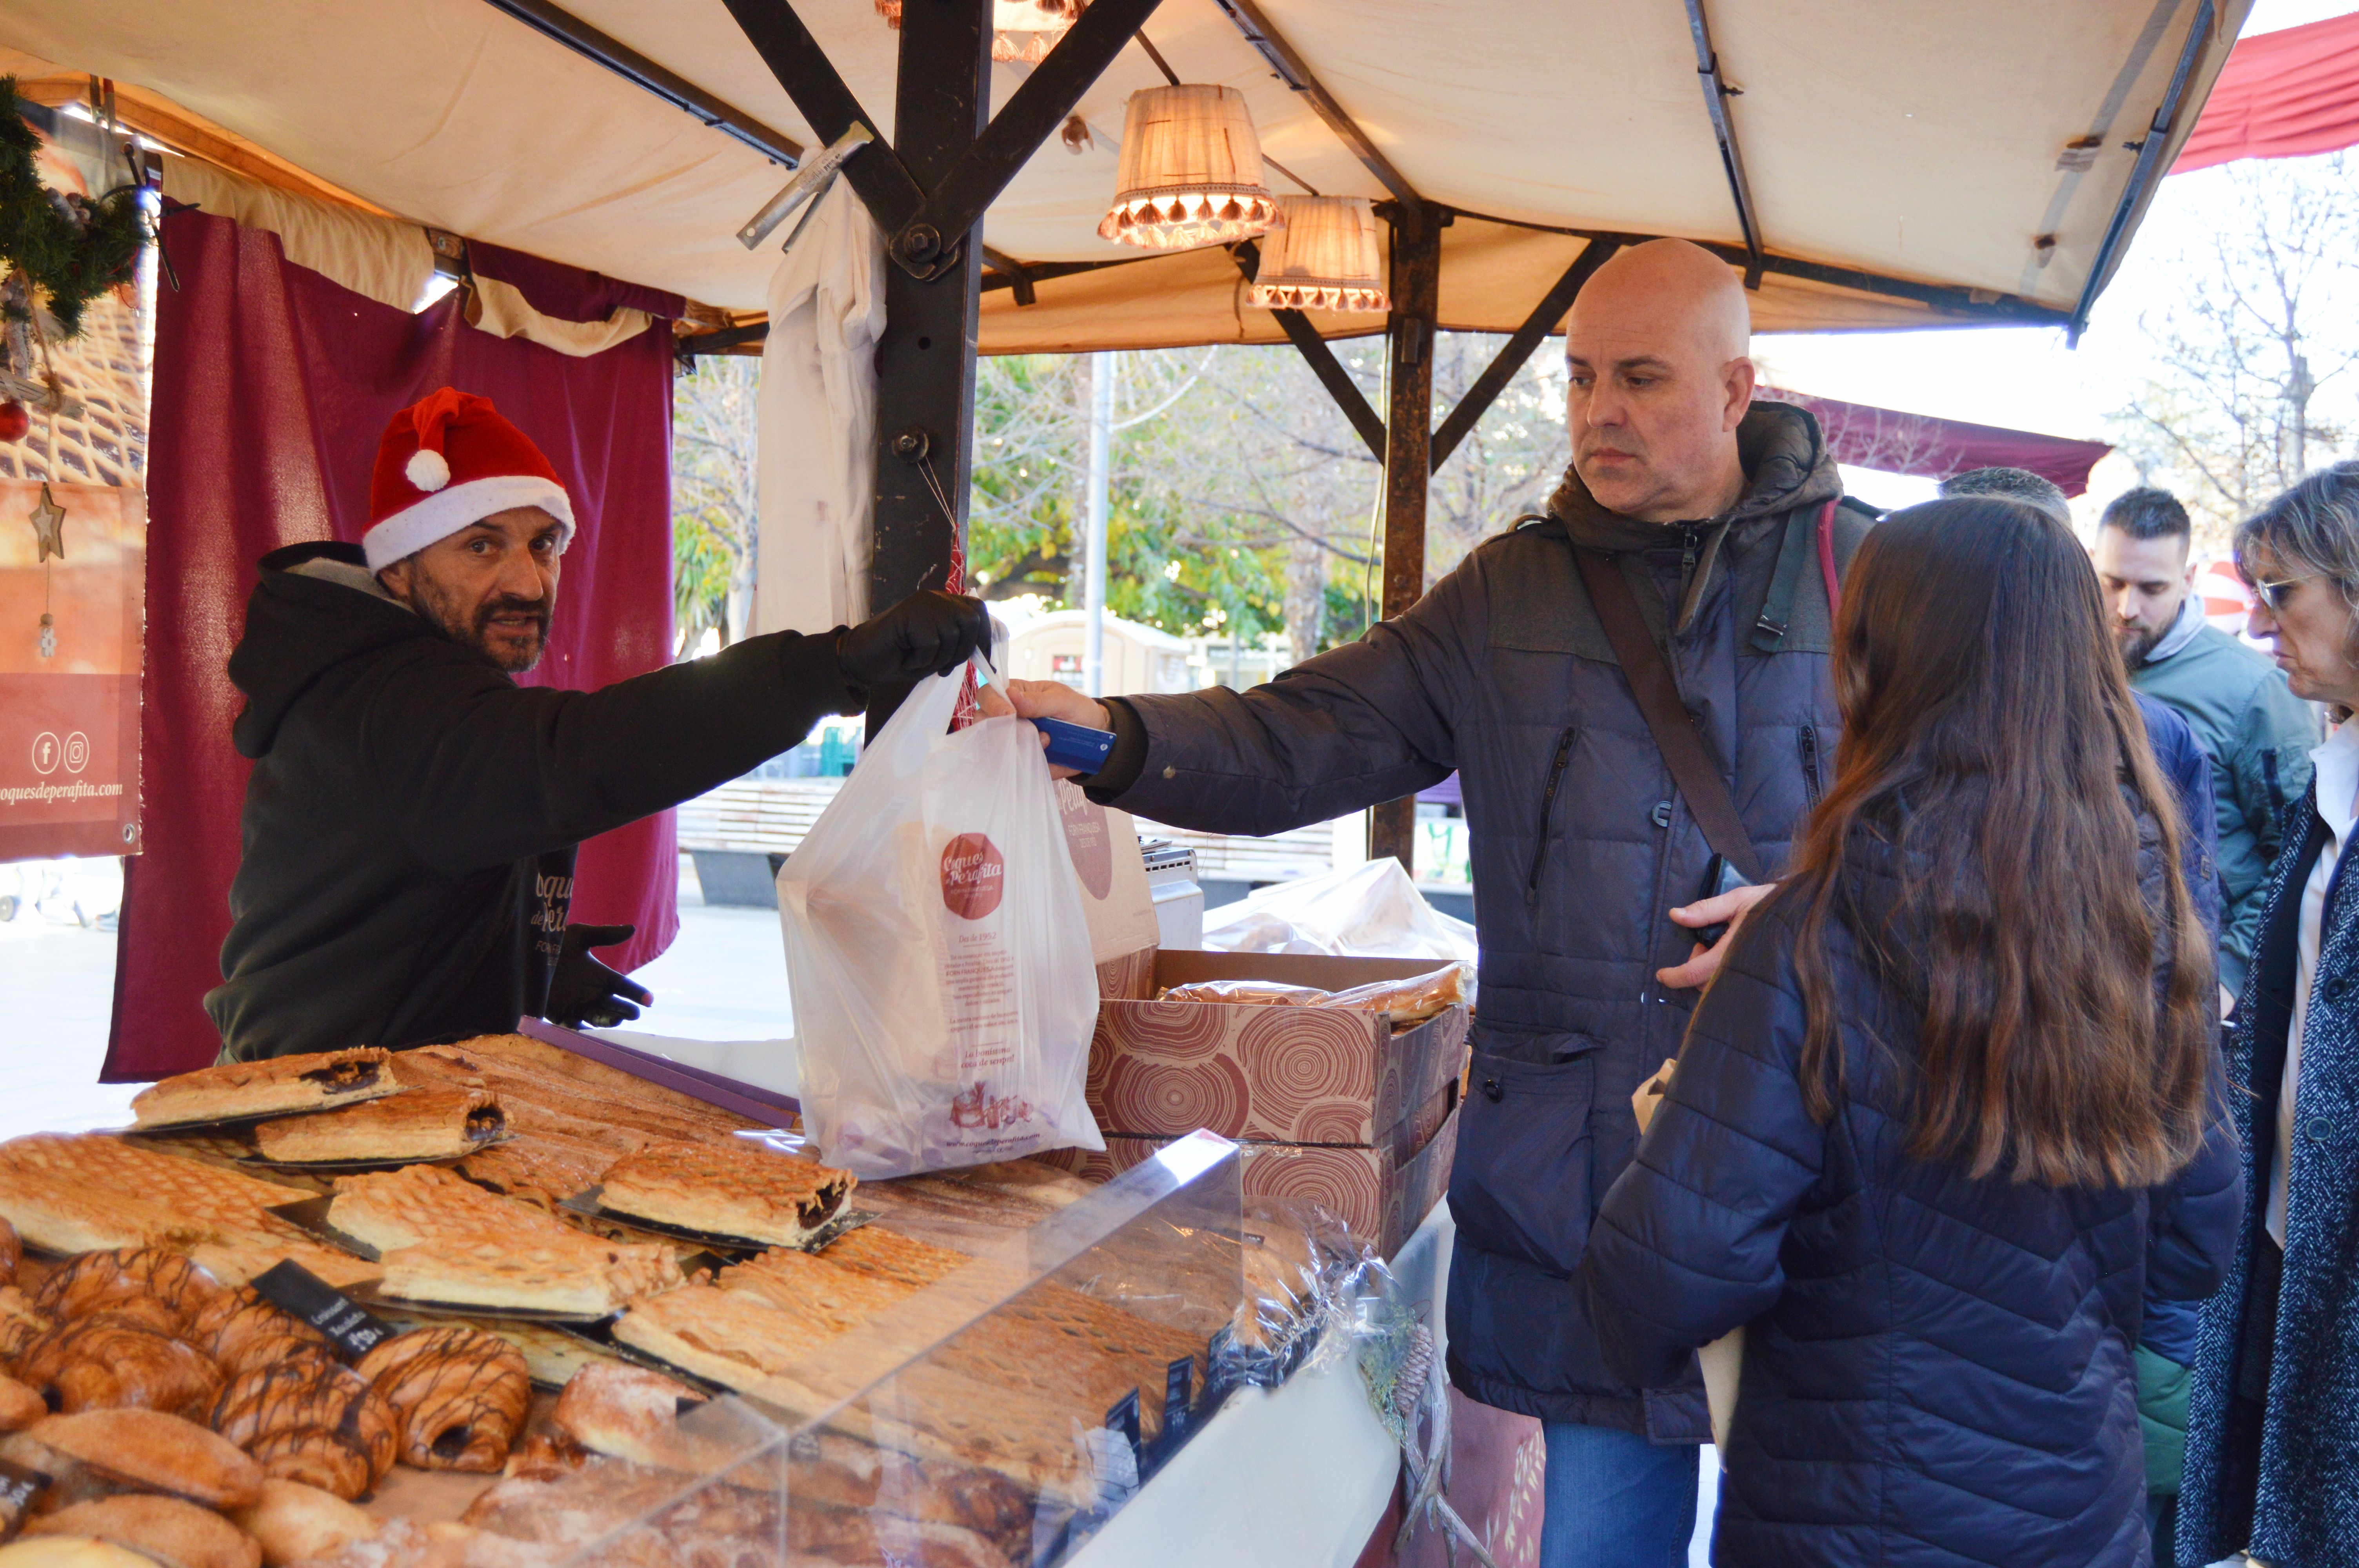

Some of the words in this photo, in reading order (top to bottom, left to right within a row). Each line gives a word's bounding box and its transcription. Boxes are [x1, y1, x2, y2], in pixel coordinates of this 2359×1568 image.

[0, 779, 123, 805] oquesdeperafita.com
[944, 851, 983, 872] Coques
[951, 863, 1002, 885] Perafita
[970, 933, 977, 942] de
[980, 931, 996, 940] 1952
